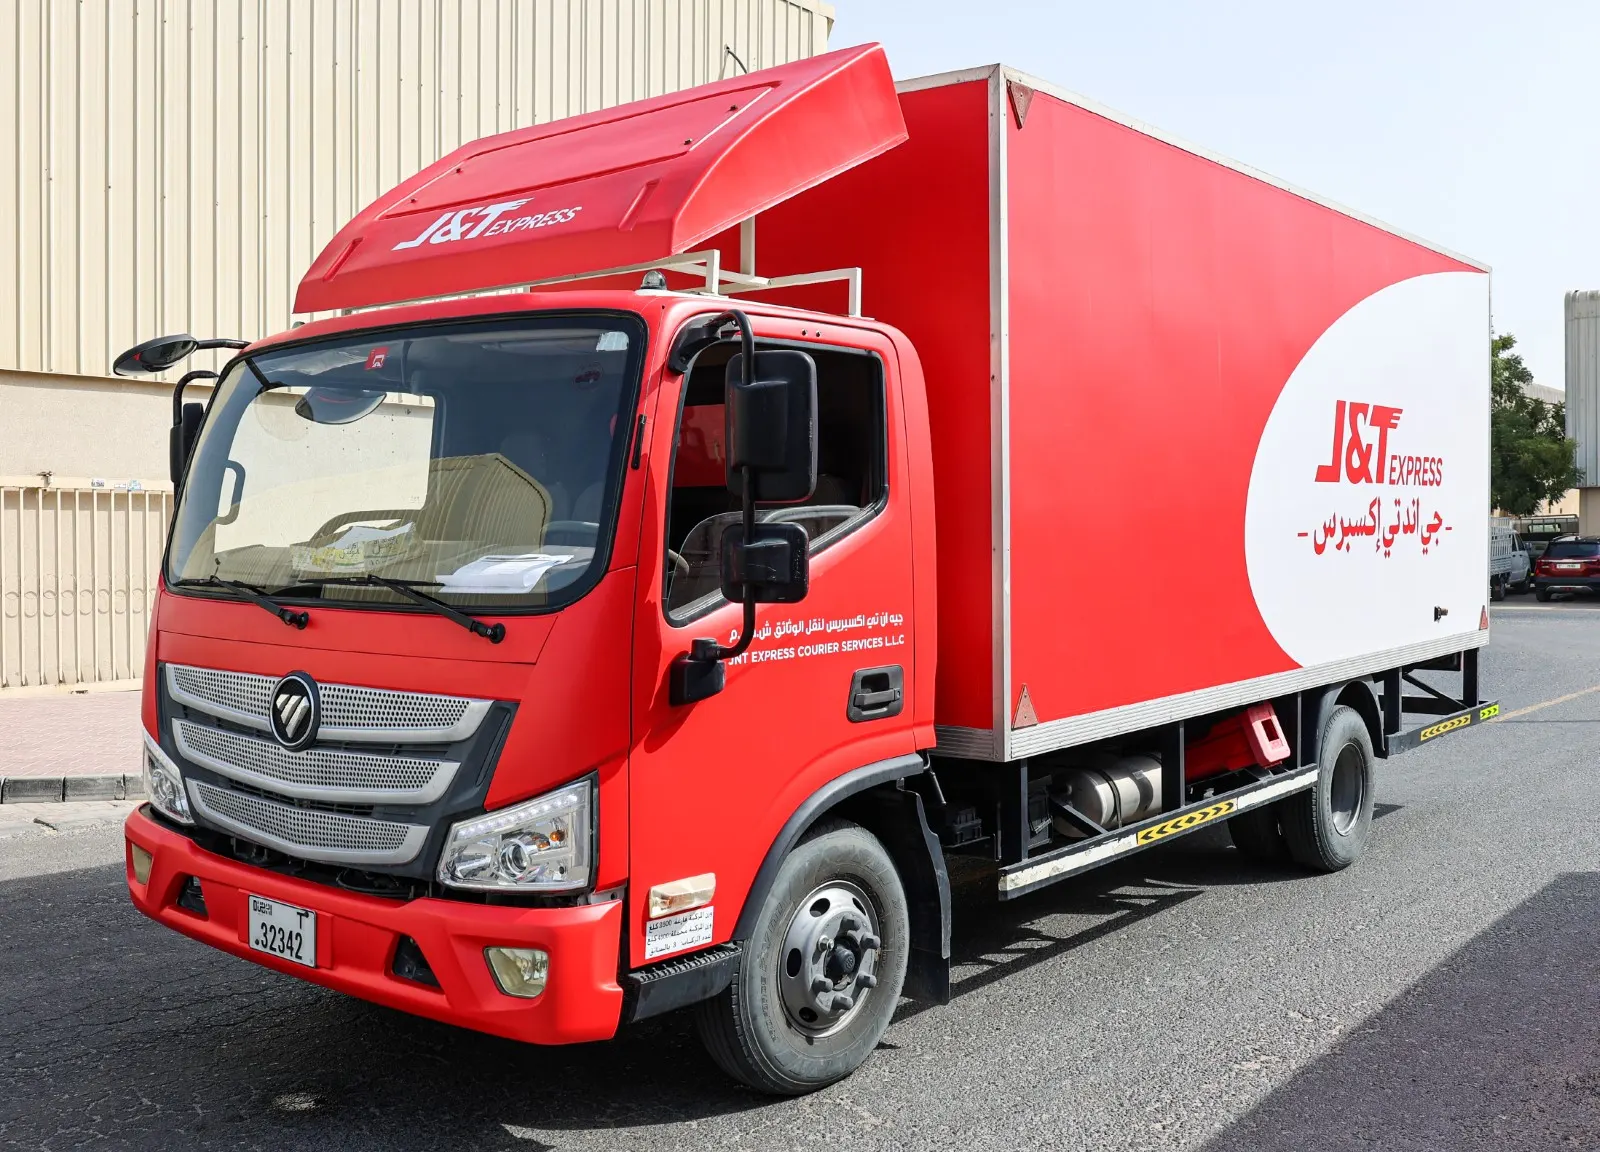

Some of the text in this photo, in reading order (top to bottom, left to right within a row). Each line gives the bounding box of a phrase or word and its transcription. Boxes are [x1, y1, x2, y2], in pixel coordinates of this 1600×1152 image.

[391, 197, 583, 251] J&T EXPRESS
[1315, 400, 1443, 486] J&T EXPRESS
[751, 647, 795, 663] EXPRESS
[797, 642, 840, 658] COURIER
[841, 637, 883, 652] SERVICES
[885, 634, 905, 647] L.L.C
[261, 922, 303, 960] 32342
